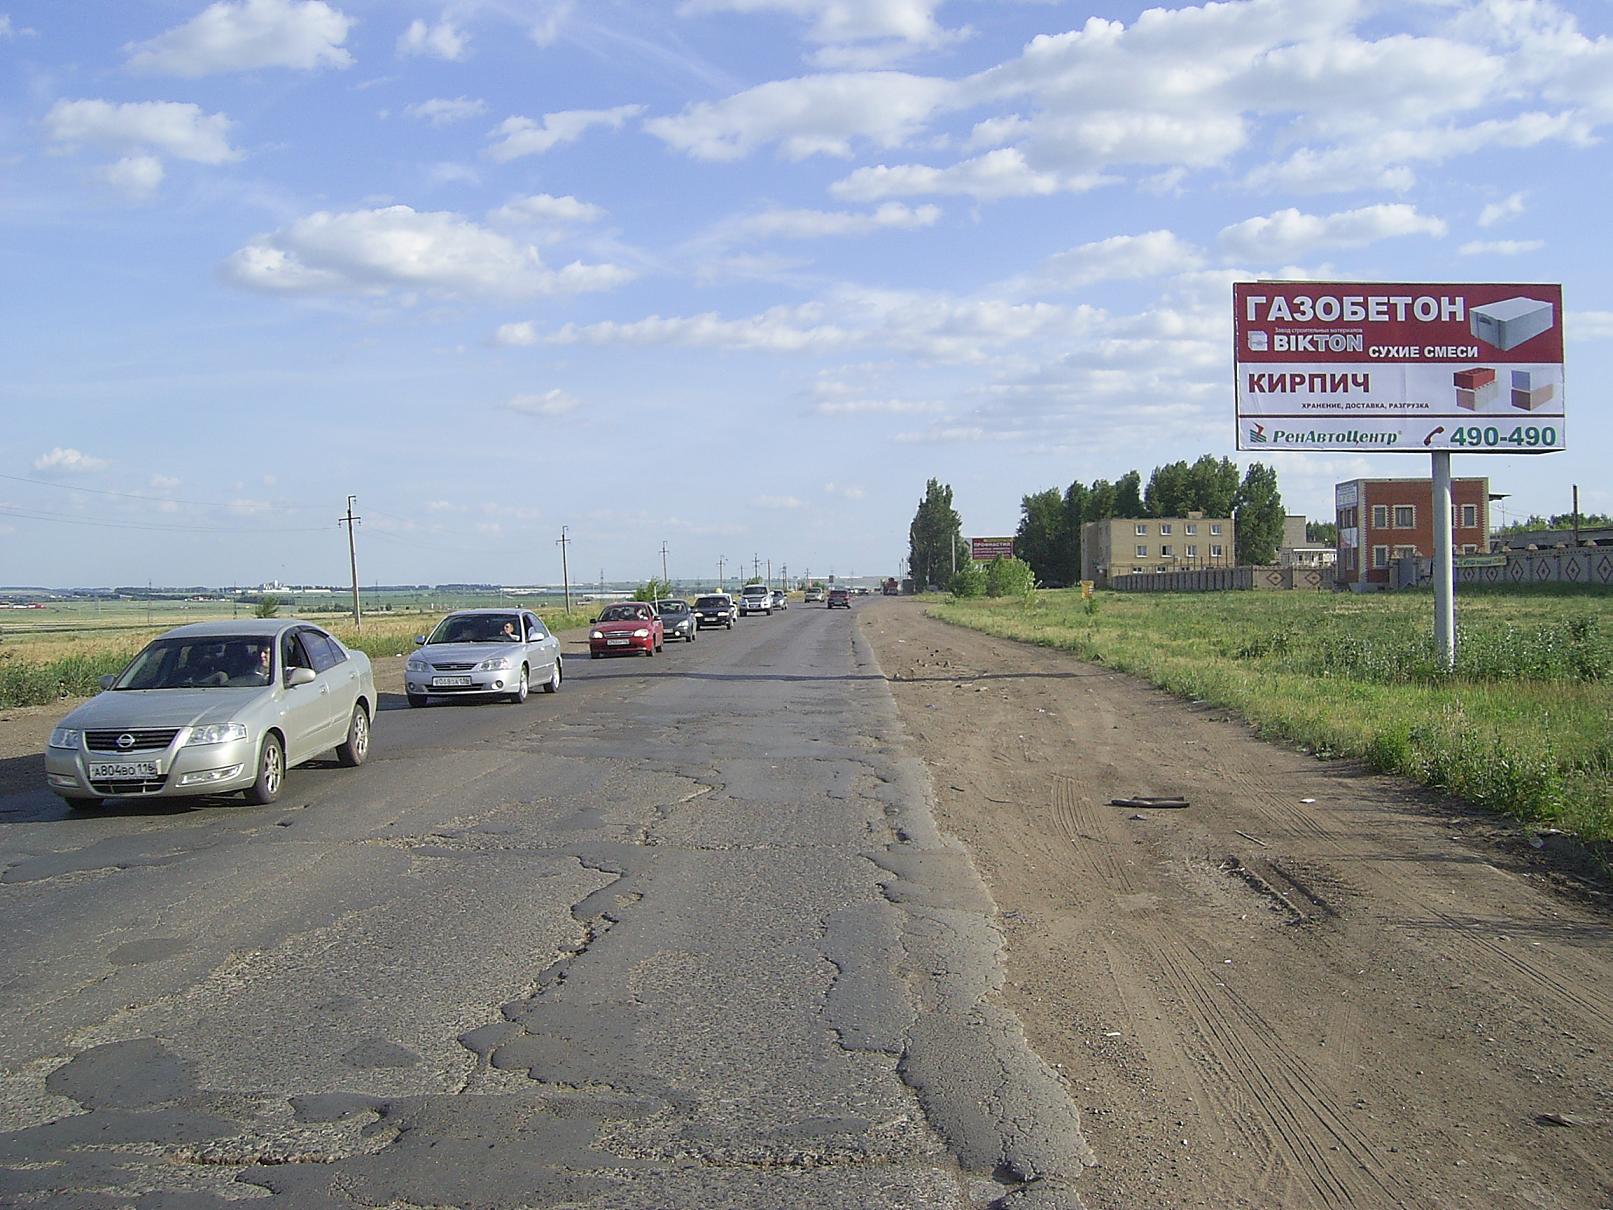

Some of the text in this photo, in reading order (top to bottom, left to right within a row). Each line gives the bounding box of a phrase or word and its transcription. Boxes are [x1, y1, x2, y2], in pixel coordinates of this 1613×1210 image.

[1246, 296, 1464, 322] ГАЗОБЕТОН
[1274, 334, 1363, 352] BIKTON
[1368, 346, 1478, 358] СУХИЕ СМЕСИ
[1248, 373, 1370, 393] КИРПИЧ
[1450, 427, 1556, 446] 490-490
